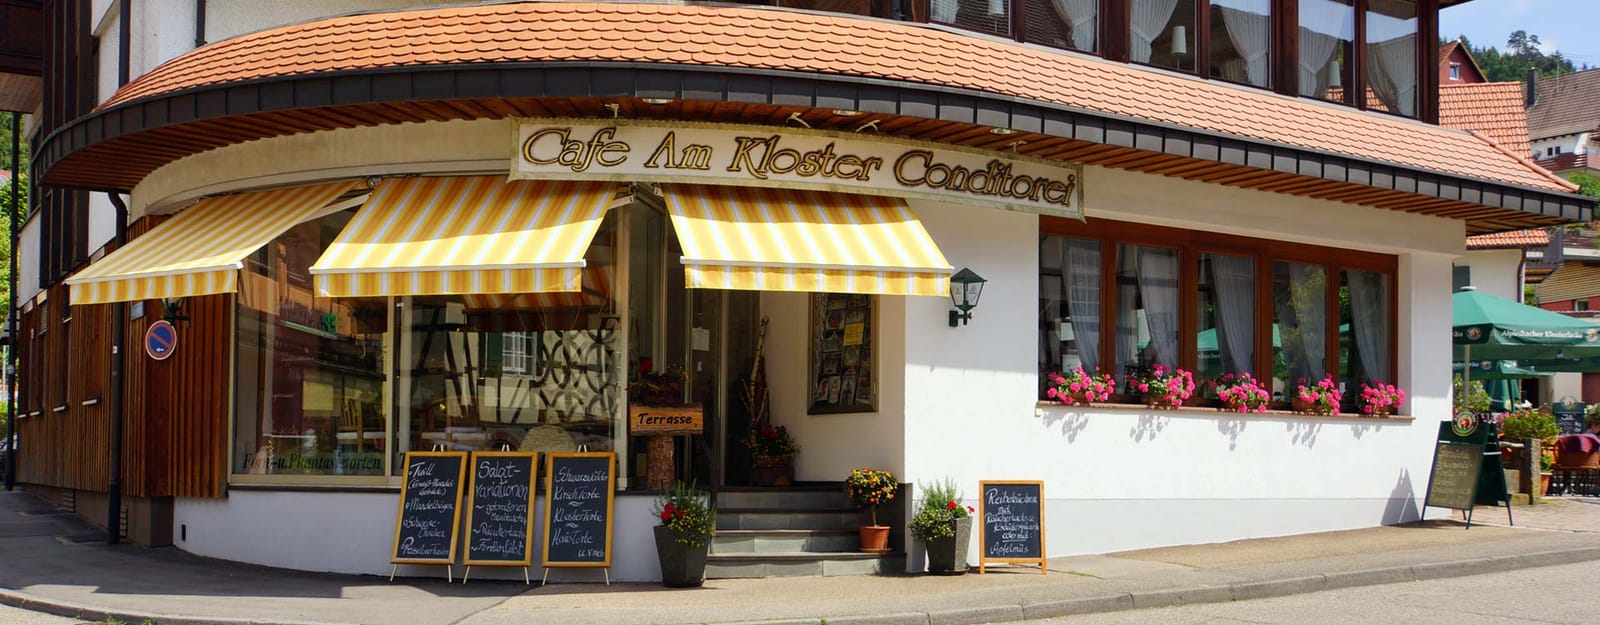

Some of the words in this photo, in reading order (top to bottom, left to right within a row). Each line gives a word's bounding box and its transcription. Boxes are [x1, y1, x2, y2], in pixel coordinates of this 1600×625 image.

[522, 126, 630, 172] Cafe
[644, 131, 713, 171] Am
[727, 135, 883, 180] Kloster
[893, 149, 1077, 208] Conditorei
[637, 413, 692, 425] Terrasse
[478, 461, 521, 478] Salat-
